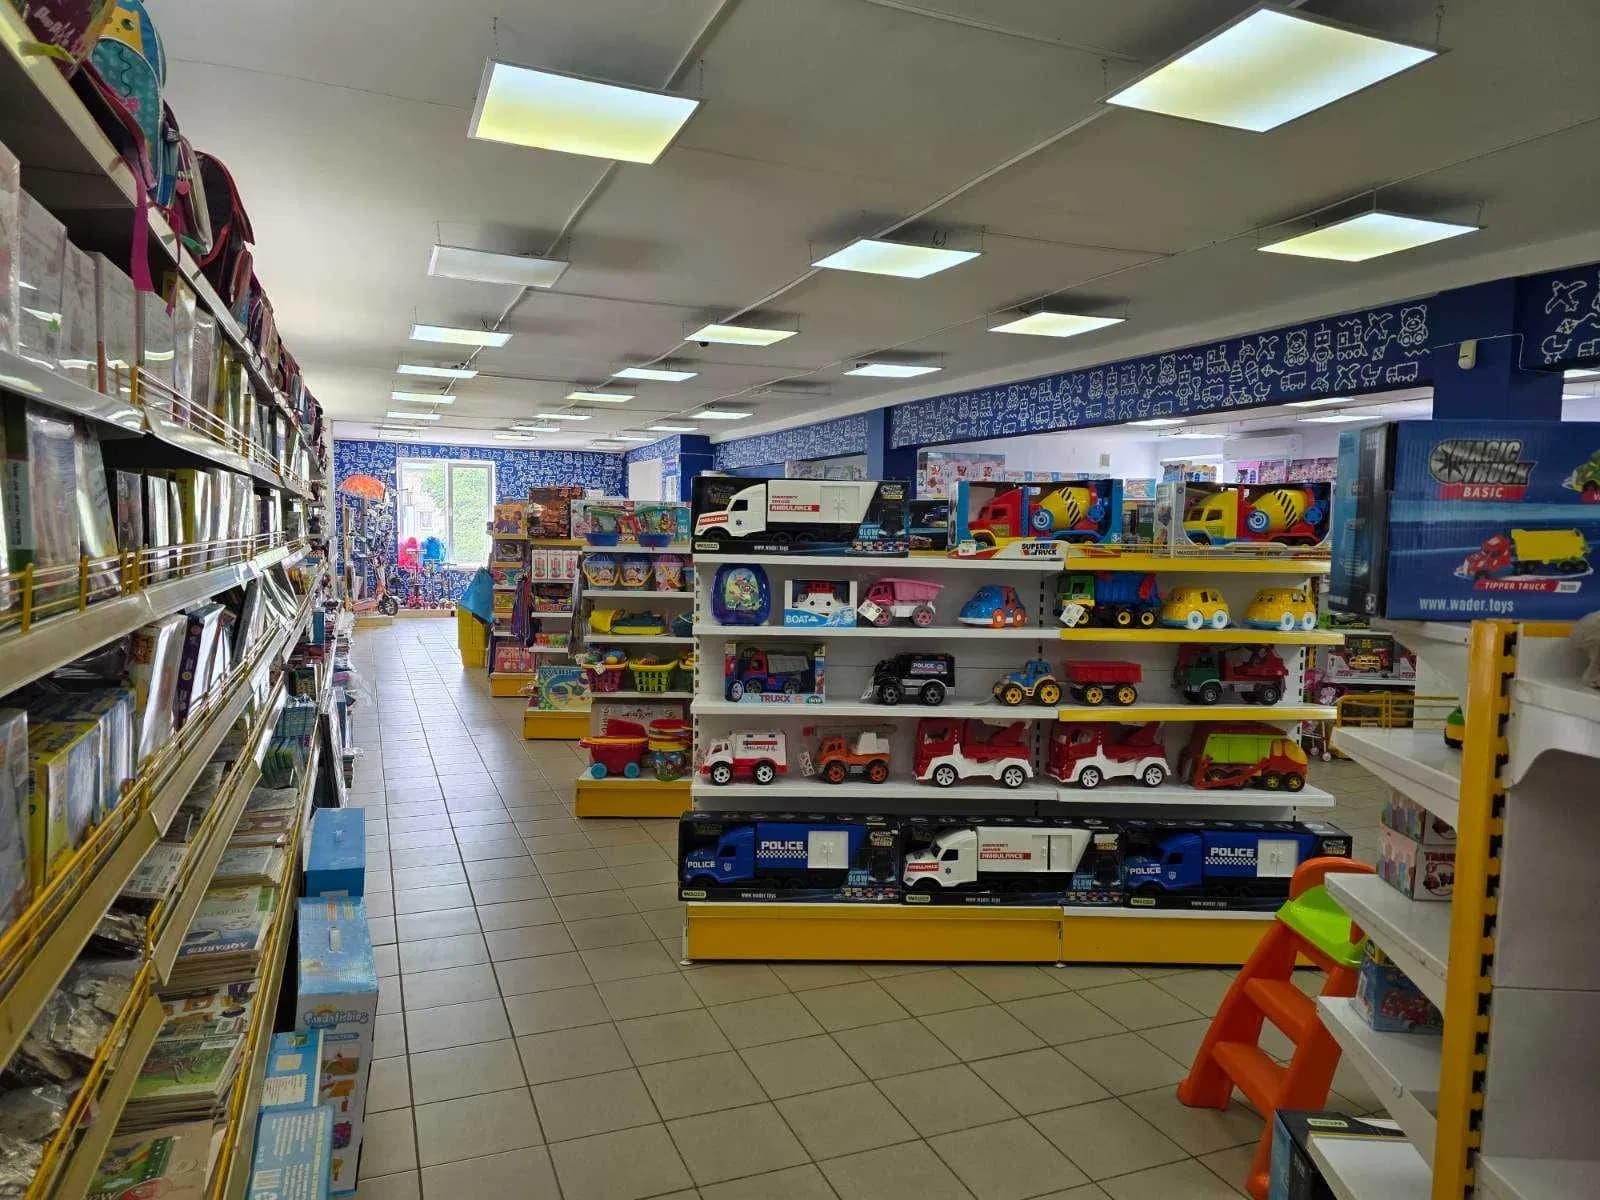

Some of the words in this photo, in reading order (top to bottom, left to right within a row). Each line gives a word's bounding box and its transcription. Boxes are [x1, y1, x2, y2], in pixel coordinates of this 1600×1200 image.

[1452, 439, 1521, 463] MAGIC
[1461, 462, 1536, 485] TRUCK
[1463, 486, 1504, 499] BASIC
[1484, 581, 1515, 591] TIPPER
[1517, 581, 1547, 591] TRUCK
[1419, 598, 1515, 613] www.wader.toys
[785, 615, 809, 624] BOAT
[761, 840, 804, 850] POLICE
[1210, 847, 1255, 858] POLICE
[687, 860, 716, 868] POLICE
[1129, 867, 1162, 875] POLICE
